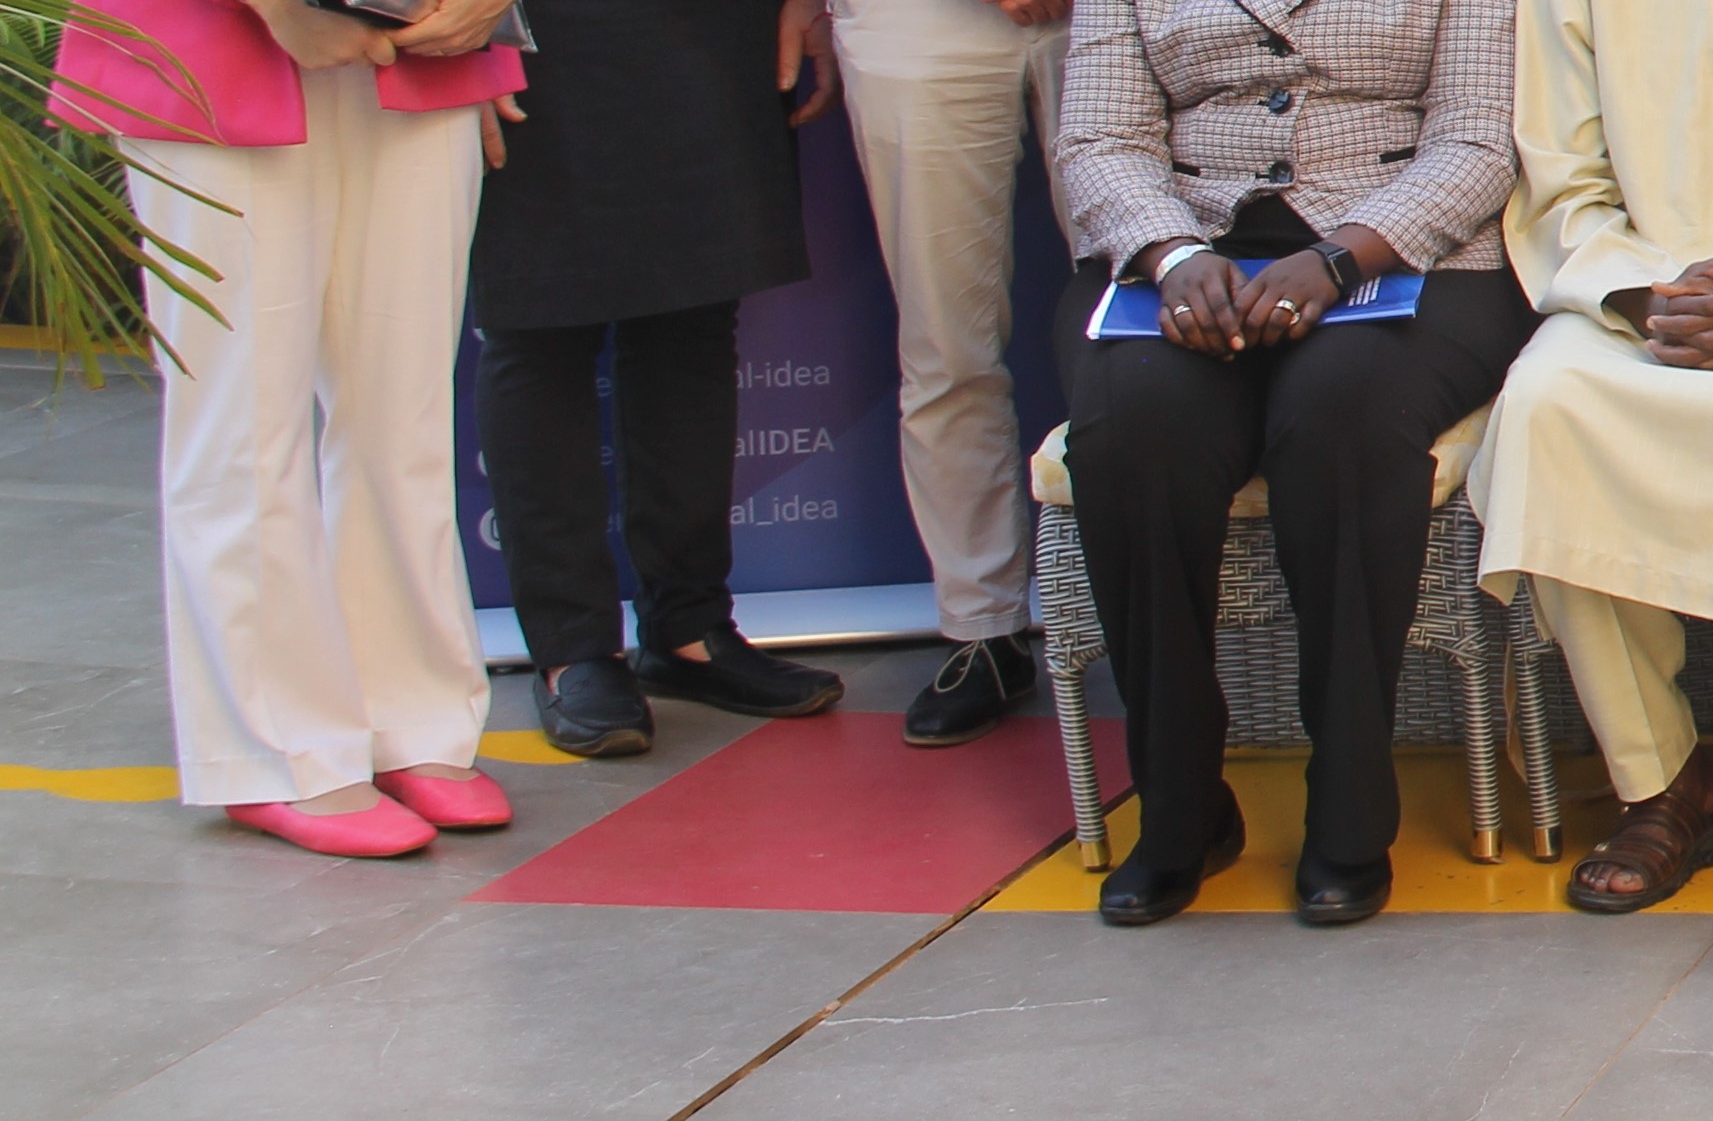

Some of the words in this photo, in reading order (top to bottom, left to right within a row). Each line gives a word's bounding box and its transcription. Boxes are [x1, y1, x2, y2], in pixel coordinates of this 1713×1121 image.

[736, 360, 830, 389] al-idea
[735, 427, 834, 457] alIDEA
[730, 494, 838, 525] al_idea
